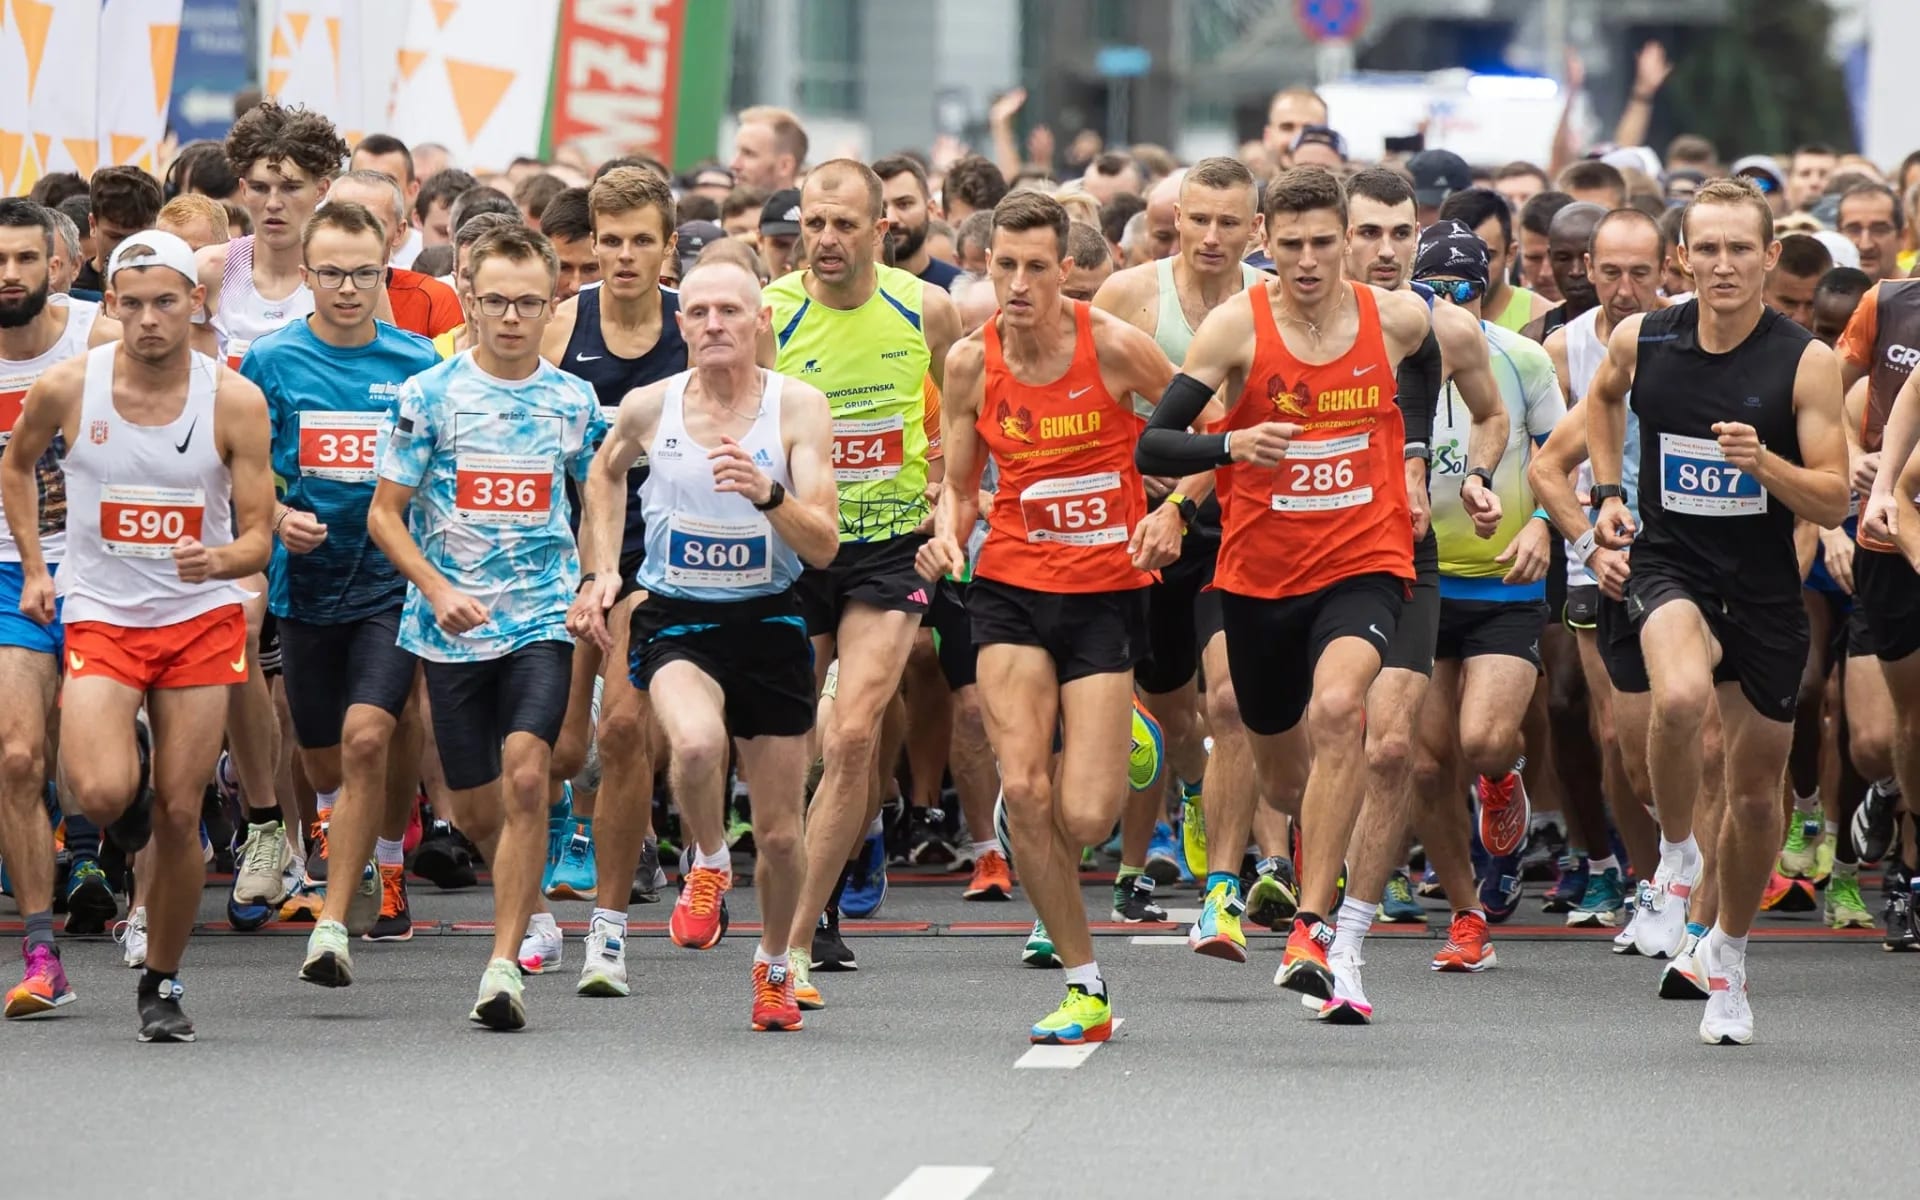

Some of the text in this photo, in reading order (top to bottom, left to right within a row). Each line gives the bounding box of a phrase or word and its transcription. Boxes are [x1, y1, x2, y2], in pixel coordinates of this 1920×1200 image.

[563, 0, 670, 166] MŻA
[881, 350, 908, 359] PIOTREK
[1887, 344, 1920, 367] GR
[825, 383, 895, 399] OWOSARZYŃSKA
[1318, 386, 1380, 412] GUKLA
[844, 400, 874, 409] GRUPA
[1040, 411, 1100, 439] GUKLA
[1304, 416, 1377, 431] CE-KORZENIOWSKI.PL
[318, 434, 377, 463] 335
[832, 438, 886, 464] 454
[1290, 459, 1354, 491] 286
[1679, 464, 1742, 493] 867
[473, 477, 536, 507] 336
[118, 509, 184, 539] 590
[1046, 497, 1107, 528] 153
[683, 541, 750, 567] 860
[770, 965, 786, 983] 86
